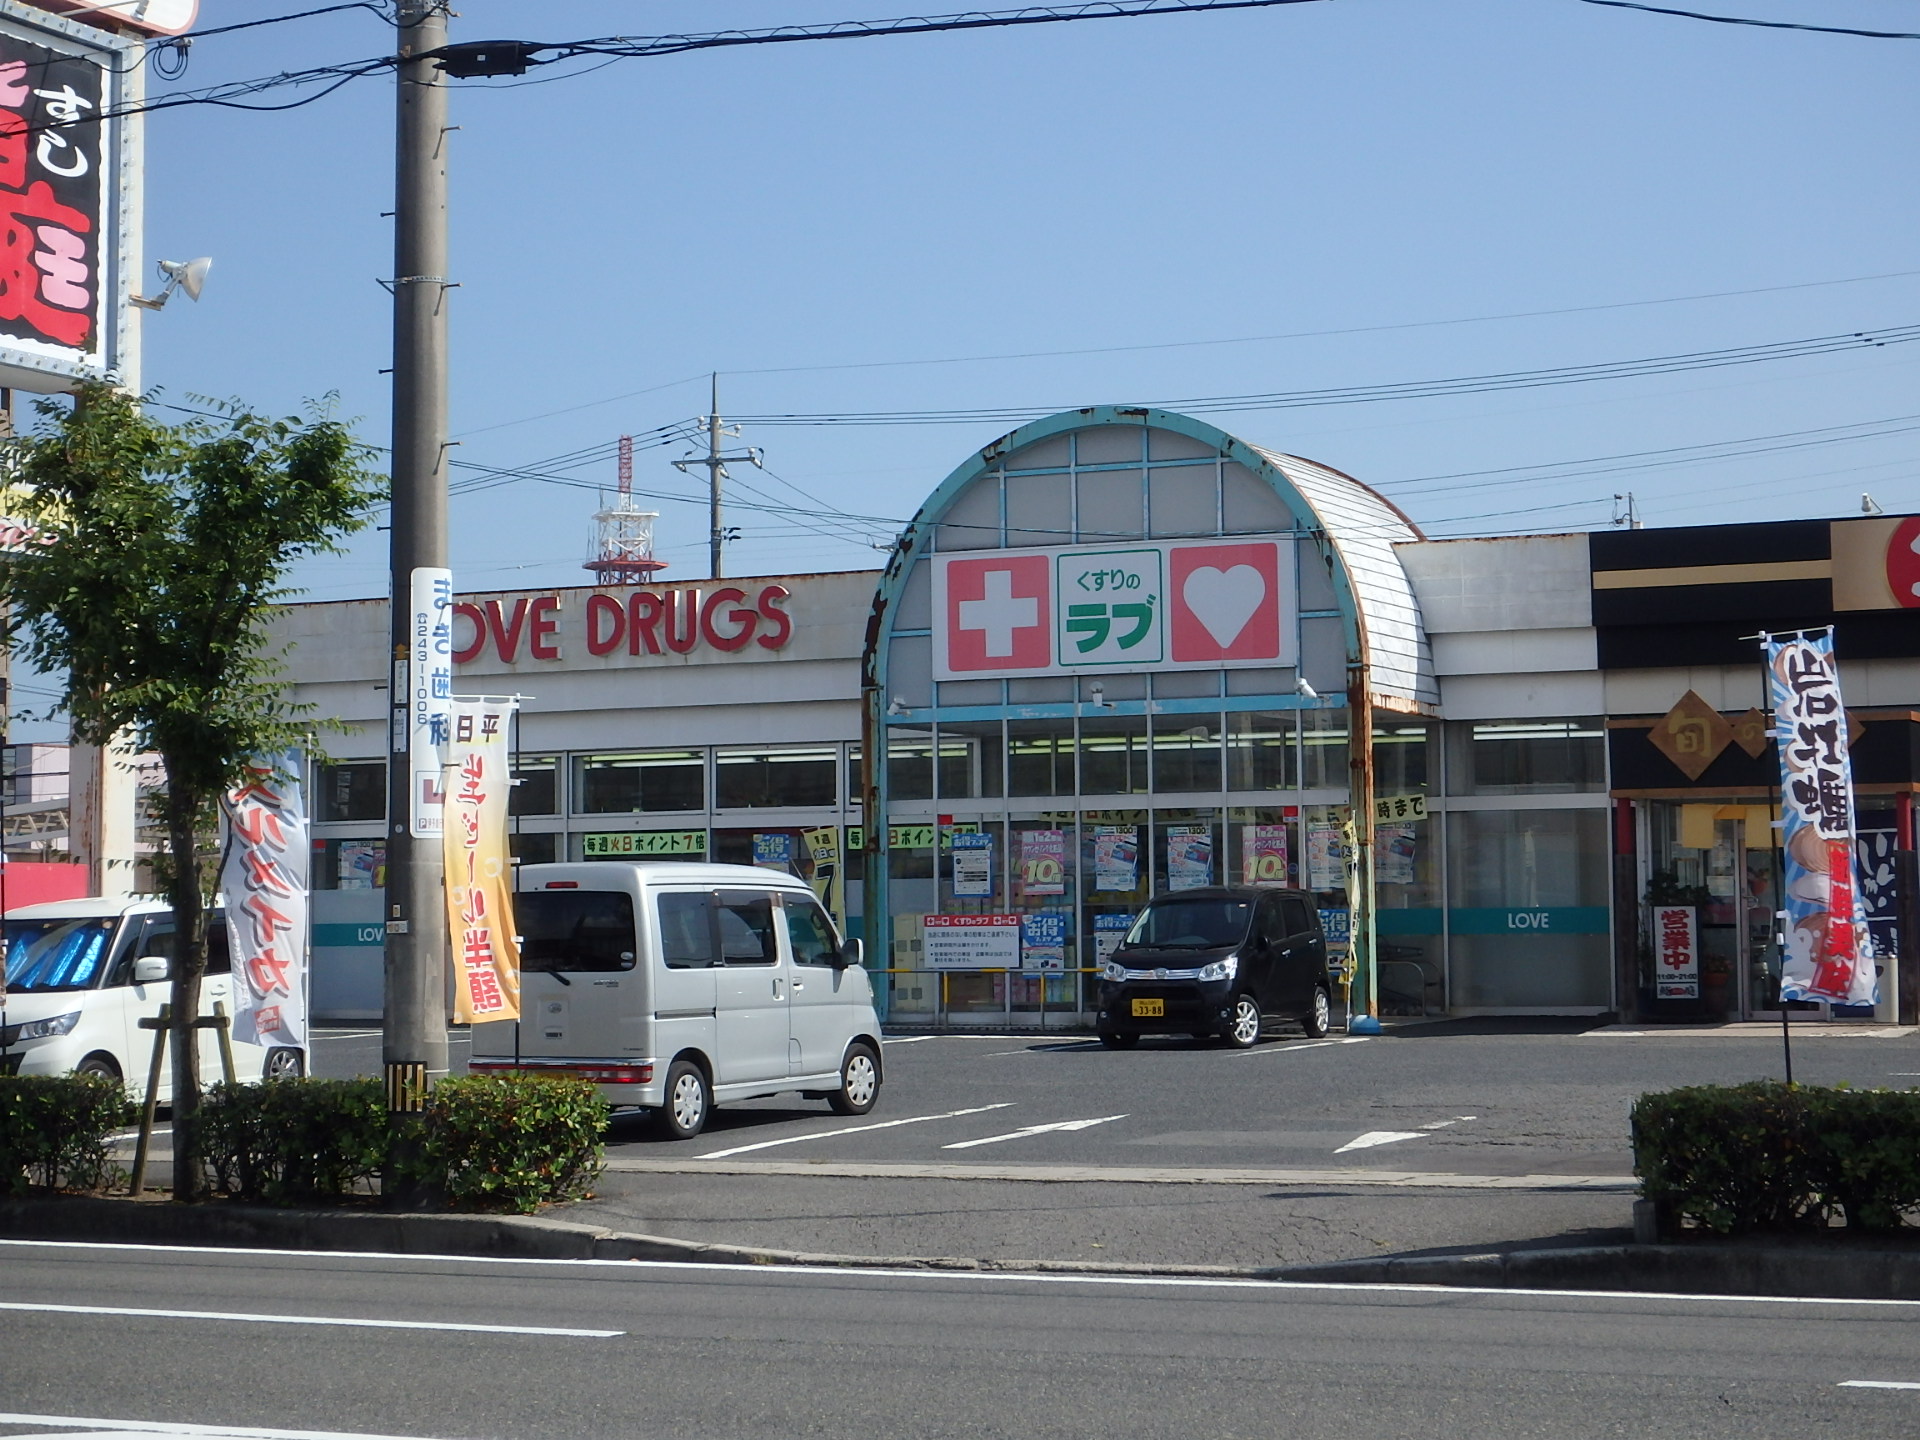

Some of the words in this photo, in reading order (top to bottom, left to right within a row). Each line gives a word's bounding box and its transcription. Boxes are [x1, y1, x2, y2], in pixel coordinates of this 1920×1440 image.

[1077, 569, 1141, 592] くすりの
[587, 585, 791, 657] DRUGS
[1066, 593, 1157, 653] ラブ
[1377, 796, 1424, 819] 時まで
[587, 834, 706, 853] 毎週火日ポイント7倍
[1027, 917, 1059, 937] お得
[1508, 912, 1549, 929] LOVE
[1660, 908, 1690, 970] 営業中
